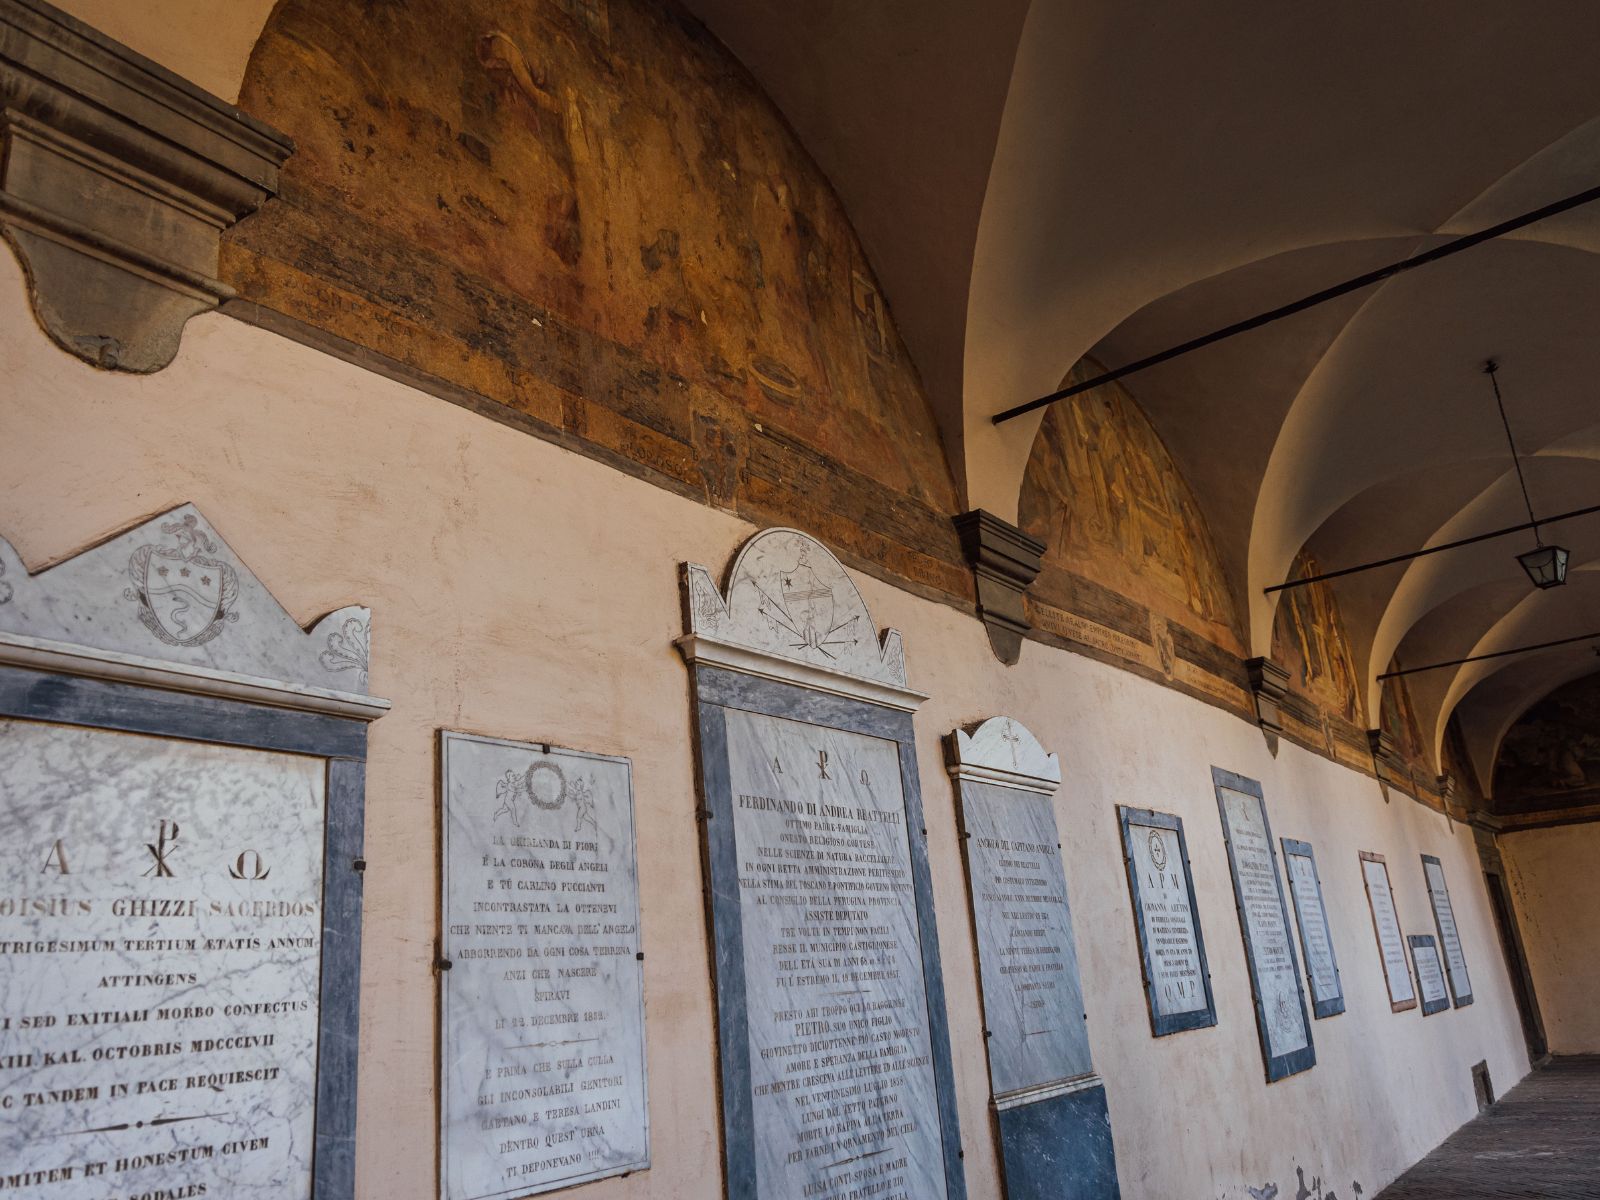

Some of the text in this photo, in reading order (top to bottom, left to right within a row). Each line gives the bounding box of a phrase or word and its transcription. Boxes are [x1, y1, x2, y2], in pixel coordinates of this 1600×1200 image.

[738, 794, 804, 816] FERDINANDO
[806, 802, 817, 817] DI
[819, 804, 855, 821] ANDREA
[785, 819, 812, 831] OTTIMO
[563, 841, 572, 850] DI
[757, 846, 854, 862] NELLE SCIENZE NATURA
[494, 858, 608, 873] LA CORONA DEGLI ANGELI
[745, 862, 754, 873] IN
[757, 863, 775, 873] OGNI
[487, 880, 606, 893] E CARLINO PUCCIANTI
[111, 897, 196, 918] GHIZZI
[209, 900, 315, 918] SACERDOS
[473, 902, 617, 915] INCONTRASTATA LA OTTENEVI
[804, 910, 834, 921] ASSISTE
[450, 924, 471, 936] CHE
[475, 924, 513, 936] NIENTE
[517, 924, 528, 936] TI
[0, 936, 315, 955] TRIGESIMUM TERTIUM ÆTATIS ANNUM
[543, 947, 565, 958] OGNI
[568, 946, 590, 957] COSA
[593, 945, 632, 956] TERRENA
[810, 941, 847, 953] MUNICIPIO
[97, 972, 198, 989] ATTINGENS
[503, 966, 598, 981] ANZI CHE NASCERE
[797, 975, 830, 986] ESTREMO
[534, 989, 571, 1002] SPIRAVI
[19, 1000, 309, 1029] SED EXITIALI MORBO CONFECTUS
[530, 1011, 580, 1027] DECEMBRE
[795, 1020, 830, 1037] PIETRO
[833, 1022, 847, 1033] SUO
[44, 1034, 275, 1066] KAL. OCTOBRIS MDCCCLVII
[760, 1042, 808, 1059] GIOVINETTO
[484, 1054, 615, 1080] E PRIMA CHE SULLA CULLA
[785, 1060, 811, 1074] AMORE
[23, 1067, 280, 1108] TANDEM IN PACE REQUIESCIT
[477, 1075, 624, 1106] GLI INCONSOLABILI GENITORI
[754, 1084, 770, 1097] CHE
[795, 1096, 811, 1108] NEL
[532, 1111, 540, 1123] E
[545, 1105, 580, 1120] TERESA
[584, 1098, 622, 1115] LANDINI
[84, 1161, 108, 1178] ET
[114, 1145, 214, 1173] HONESTUM
[222, 1137, 270, 1156] CIVEM
[506, 1152, 583, 1179] TI DEPONEVANO
